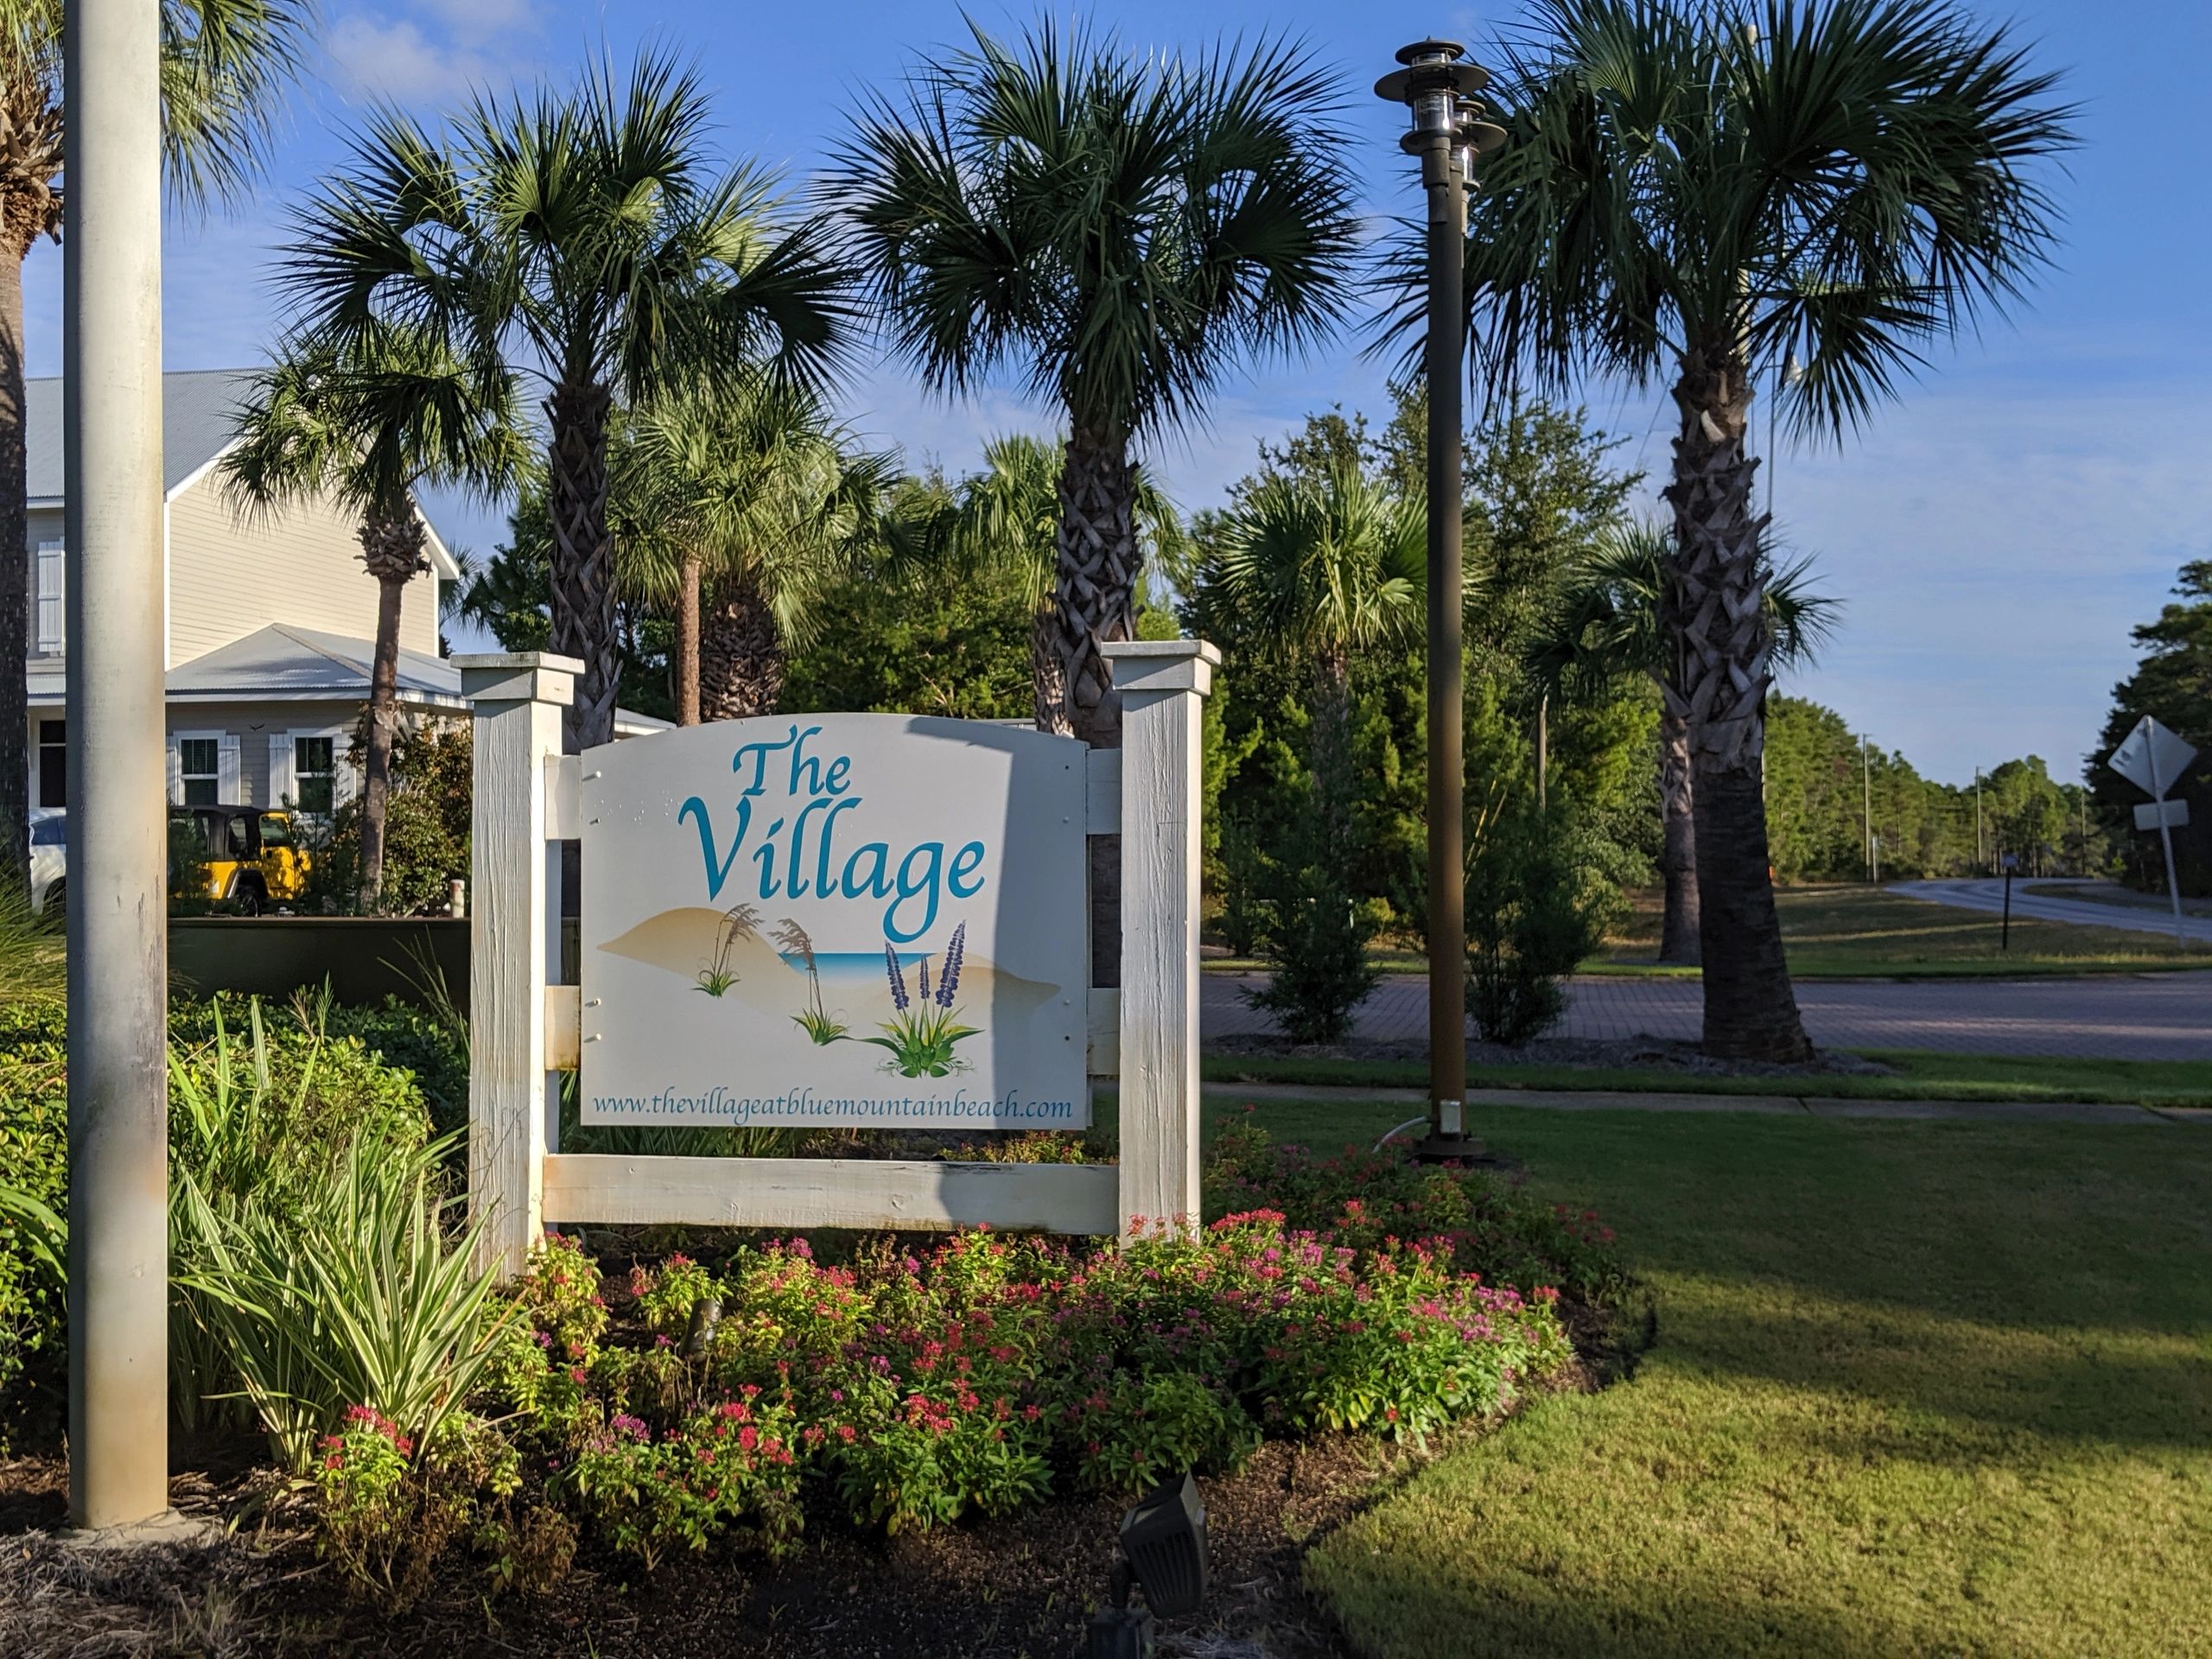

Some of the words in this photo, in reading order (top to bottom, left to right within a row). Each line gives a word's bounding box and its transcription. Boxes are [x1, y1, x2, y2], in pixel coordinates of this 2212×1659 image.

[733, 725, 851, 796] The
[678, 796, 985, 943] Village
[594, 1087, 1072, 1125] www.thevillageatbluemountainbeach.com
